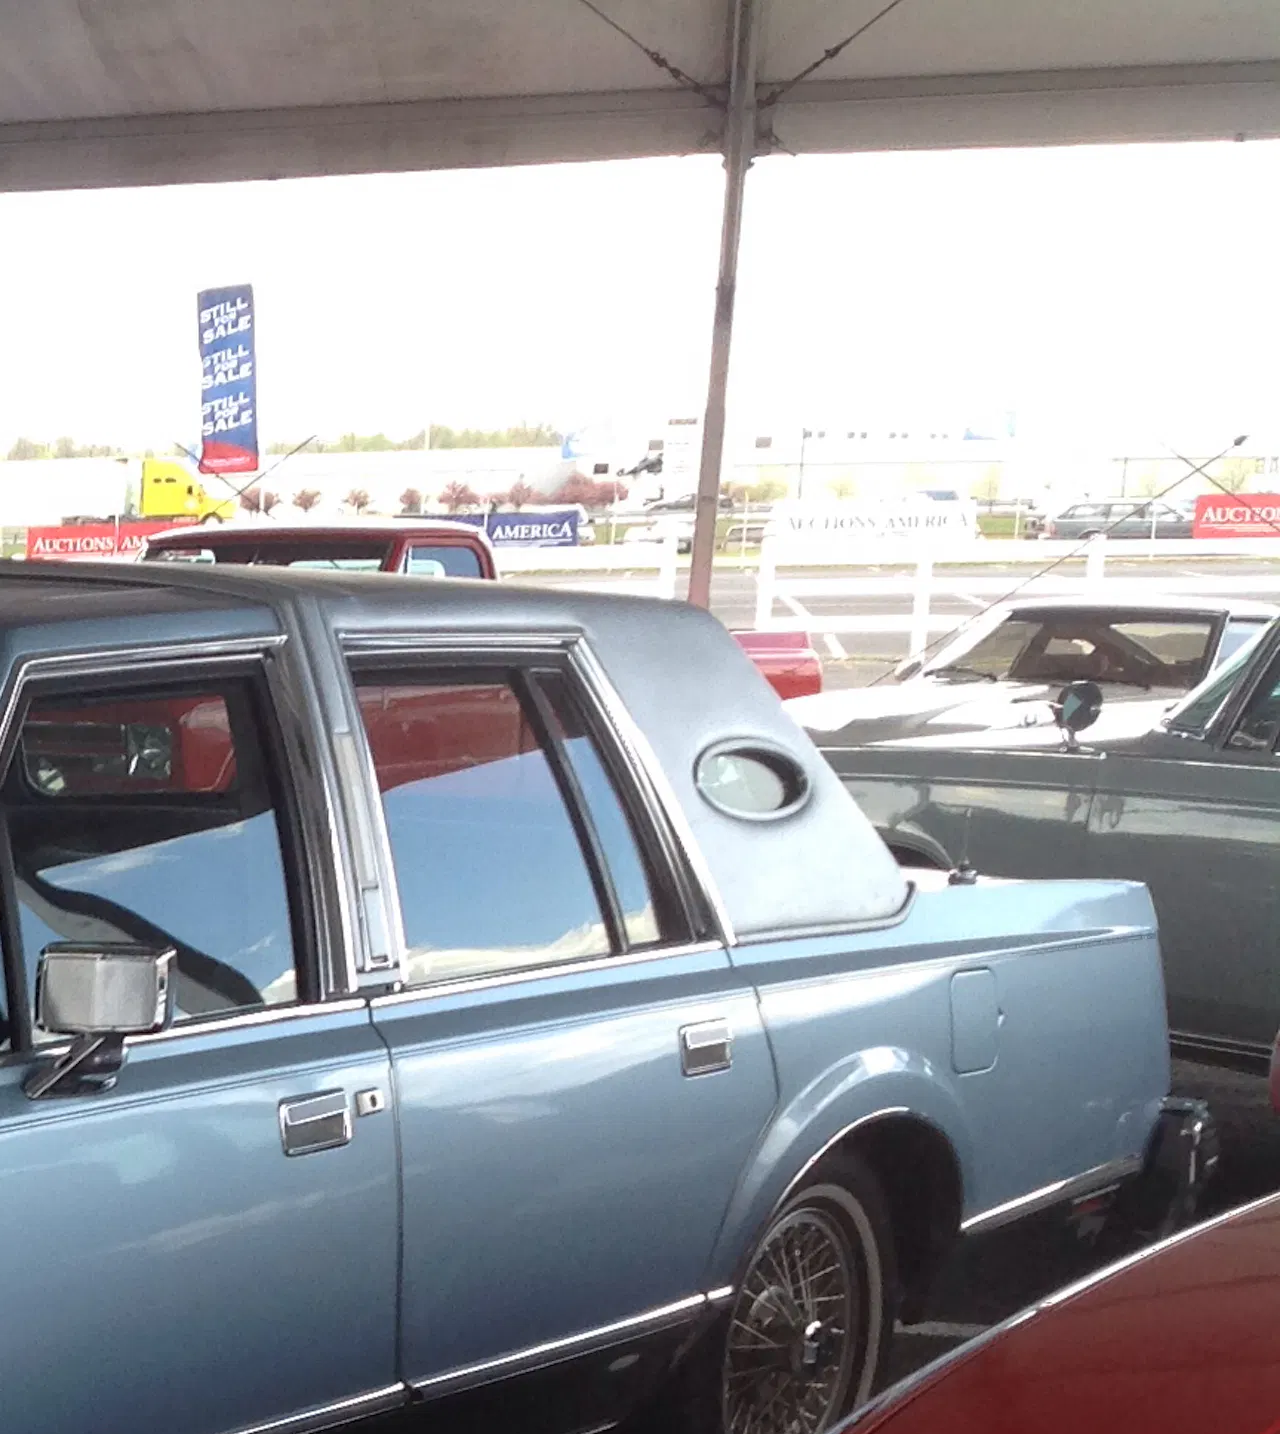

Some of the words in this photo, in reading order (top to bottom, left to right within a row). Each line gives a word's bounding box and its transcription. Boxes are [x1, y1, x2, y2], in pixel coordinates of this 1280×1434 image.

[200, 297, 248, 323] STILL
[203, 315, 251, 344] SALE
[203, 344, 249, 368] STILL
[202, 361, 252, 390] SALE
[202, 392, 250, 415] STILL
[201, 409, 252, 436] SALE
[885, 512, 969, 528] AMERICA
[1201, 506, 1280, 521] AUCTIO
[493, 520, 572, 539] AMERICA
[34, 536, 115, 552] AUCTIONS
